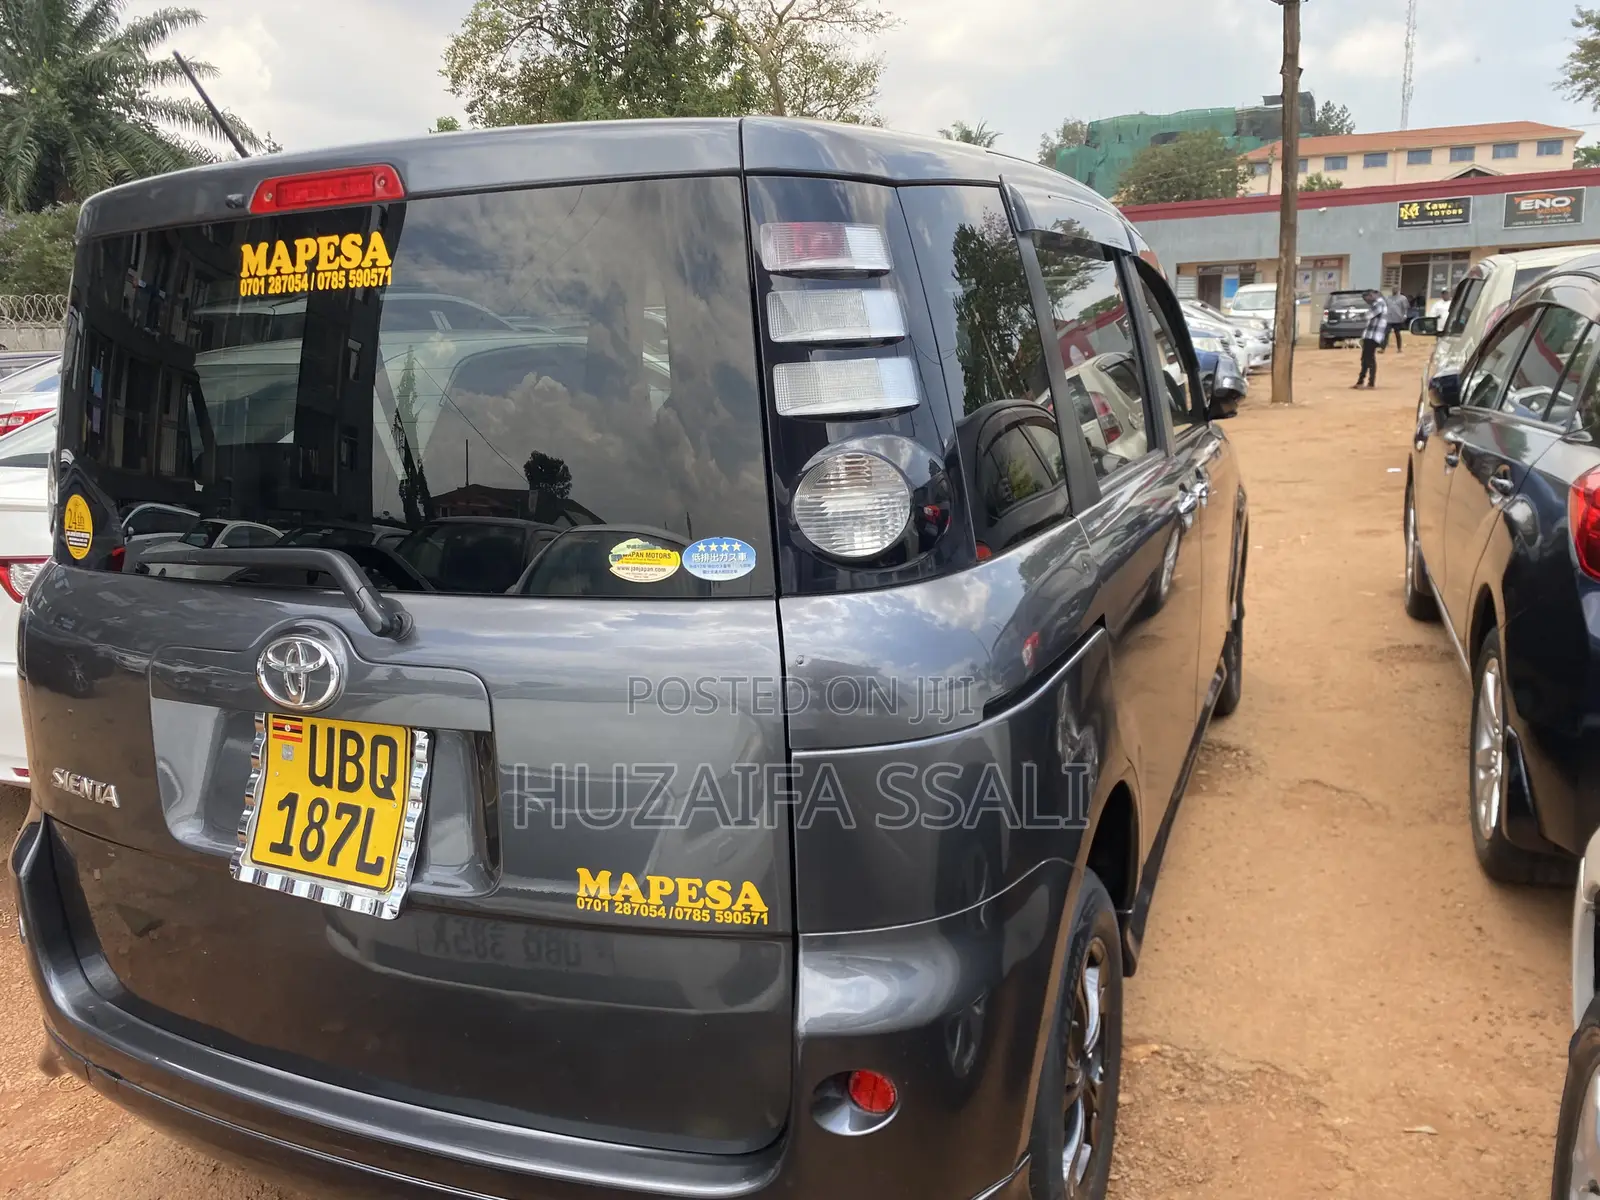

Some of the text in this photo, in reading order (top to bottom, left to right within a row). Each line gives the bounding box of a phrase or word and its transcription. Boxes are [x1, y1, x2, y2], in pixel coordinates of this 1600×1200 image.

[1519, 196, 1571, 211] ENO
[240, 231, 392, 278] MAPESA
[240, 277, 265, 297] 0701
[268, 273, 308, 294] 287054
[317, 270, 346, 291] 0785
[349, 266, 392, 287] 590571
[645, 552, 672, 560] MOTORS
[691, 552, 748, 563] 低排出ガス車
[308, 724, 398, 800] UBQ
[50, 766, 121, 809] SIENTA
[269, 792, 384, 876] 187L
[576, 867, 769, 912] MAPESA
[576, 897, 609, 913] 0701
[614, 901, 666, 919] 287054
[715, 911, 769, 926] 590571
